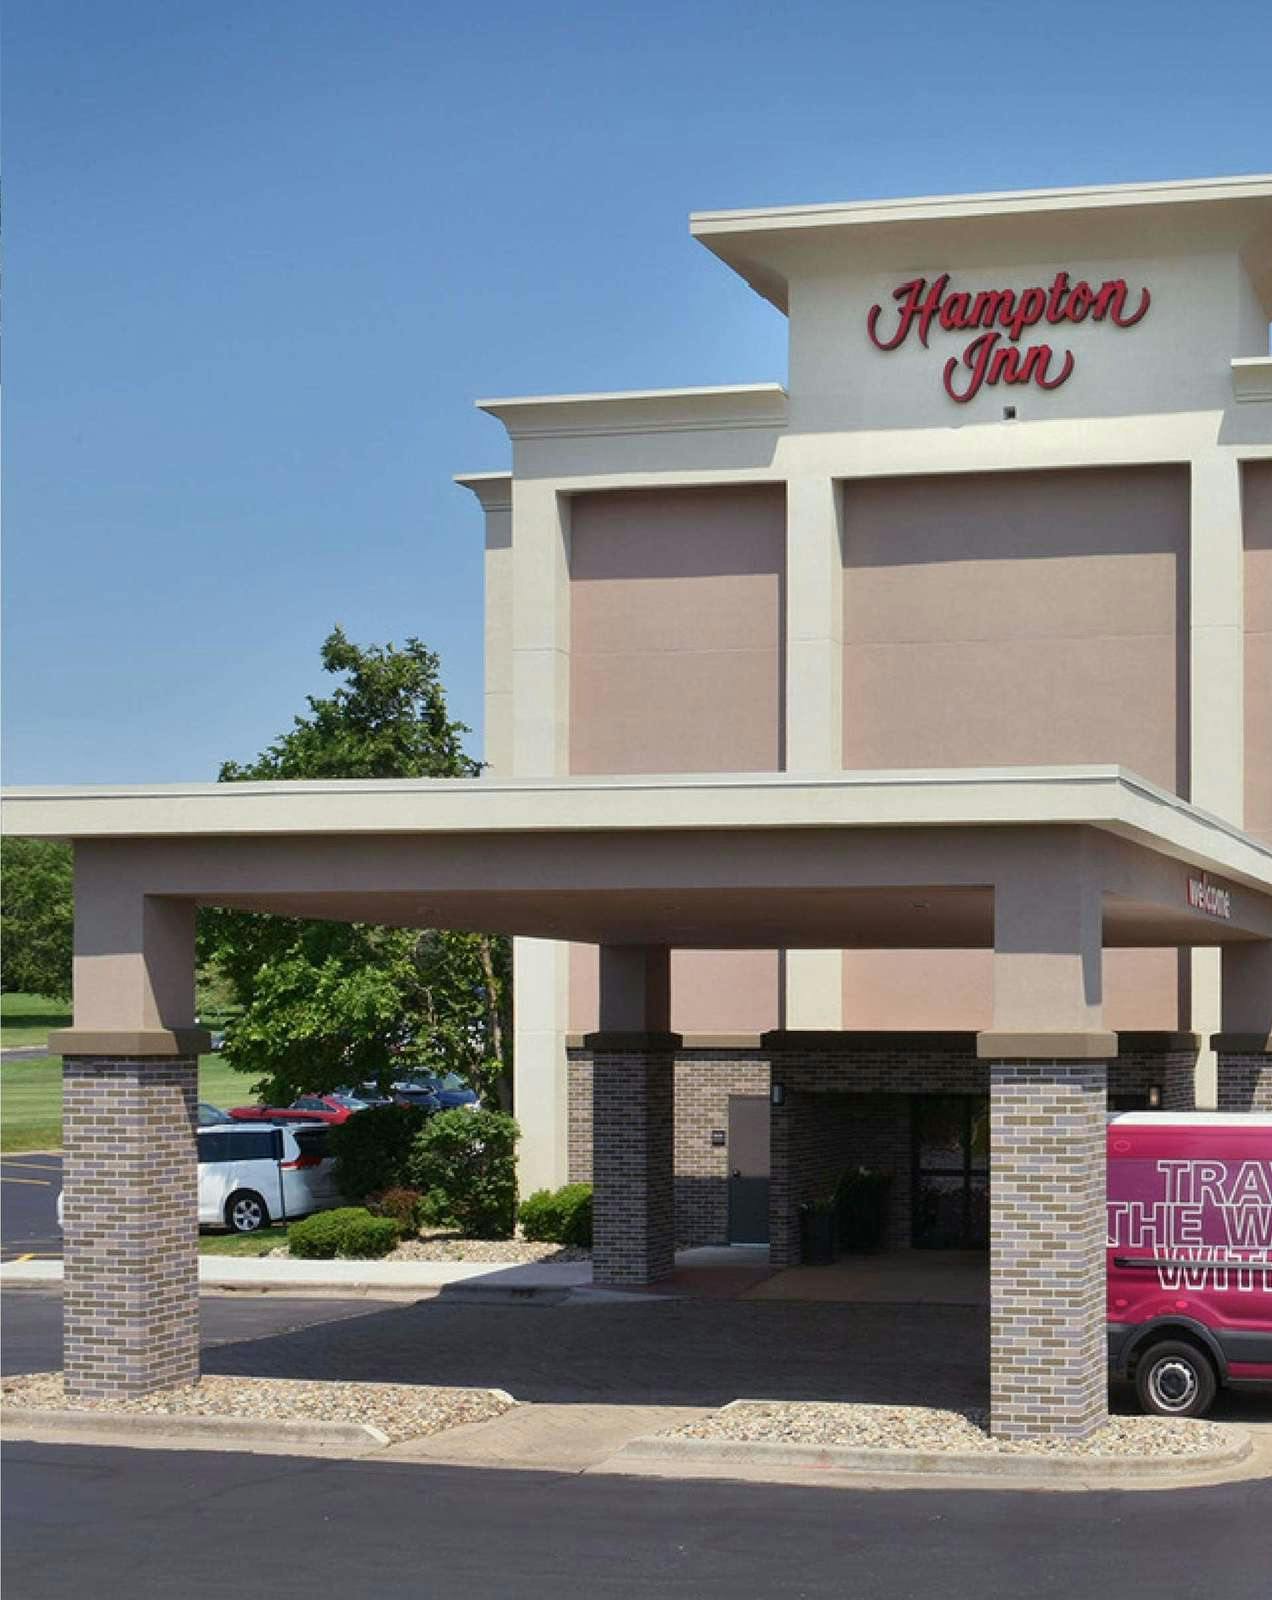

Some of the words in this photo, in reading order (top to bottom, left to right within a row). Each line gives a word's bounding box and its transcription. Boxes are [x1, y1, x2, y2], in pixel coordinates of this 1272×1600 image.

[867, 271, 1151, 351] Hampton
[943, 331, 1075, 402] Inn
[1186, 871, 1231, 919] welcome
[1106, 1202, 1203, 1248] THE
